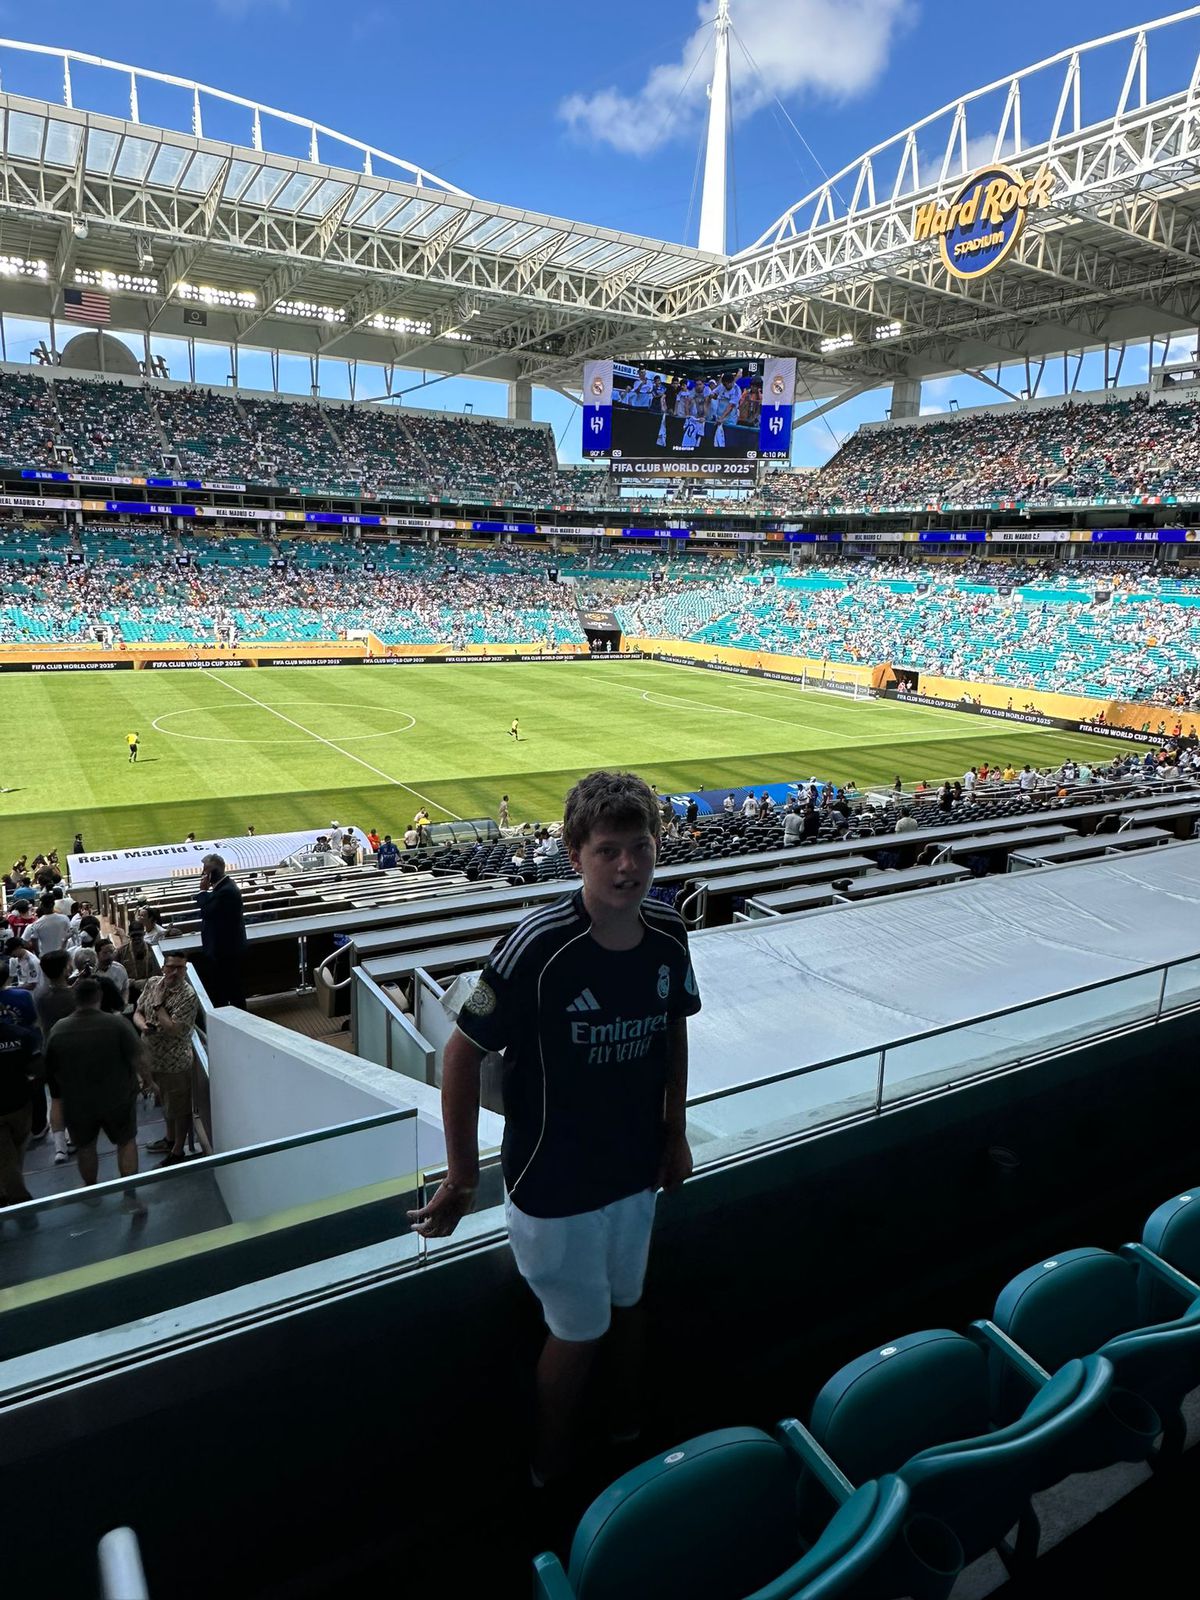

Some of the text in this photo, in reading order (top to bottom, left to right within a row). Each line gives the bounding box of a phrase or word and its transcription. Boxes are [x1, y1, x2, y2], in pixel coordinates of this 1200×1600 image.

[914, 161, 1055, 241] Hard Rock
[954, 231, 1005, 256] STADIUM
[612, 464, 632, 472] FIFA
[634, 464, 660, 472] CLUB
[662, 464, 699, 472] WORLD
[701, 464, 722, 473] CUP
[1094, 727, 1109, 735] CLUB
[1110, 729, 1133, 739] WORLD
[78, 854, 118, 864] Real
[124, 845, 188, 859] Madrid
[588, 1046, 612, 1064] FLY
